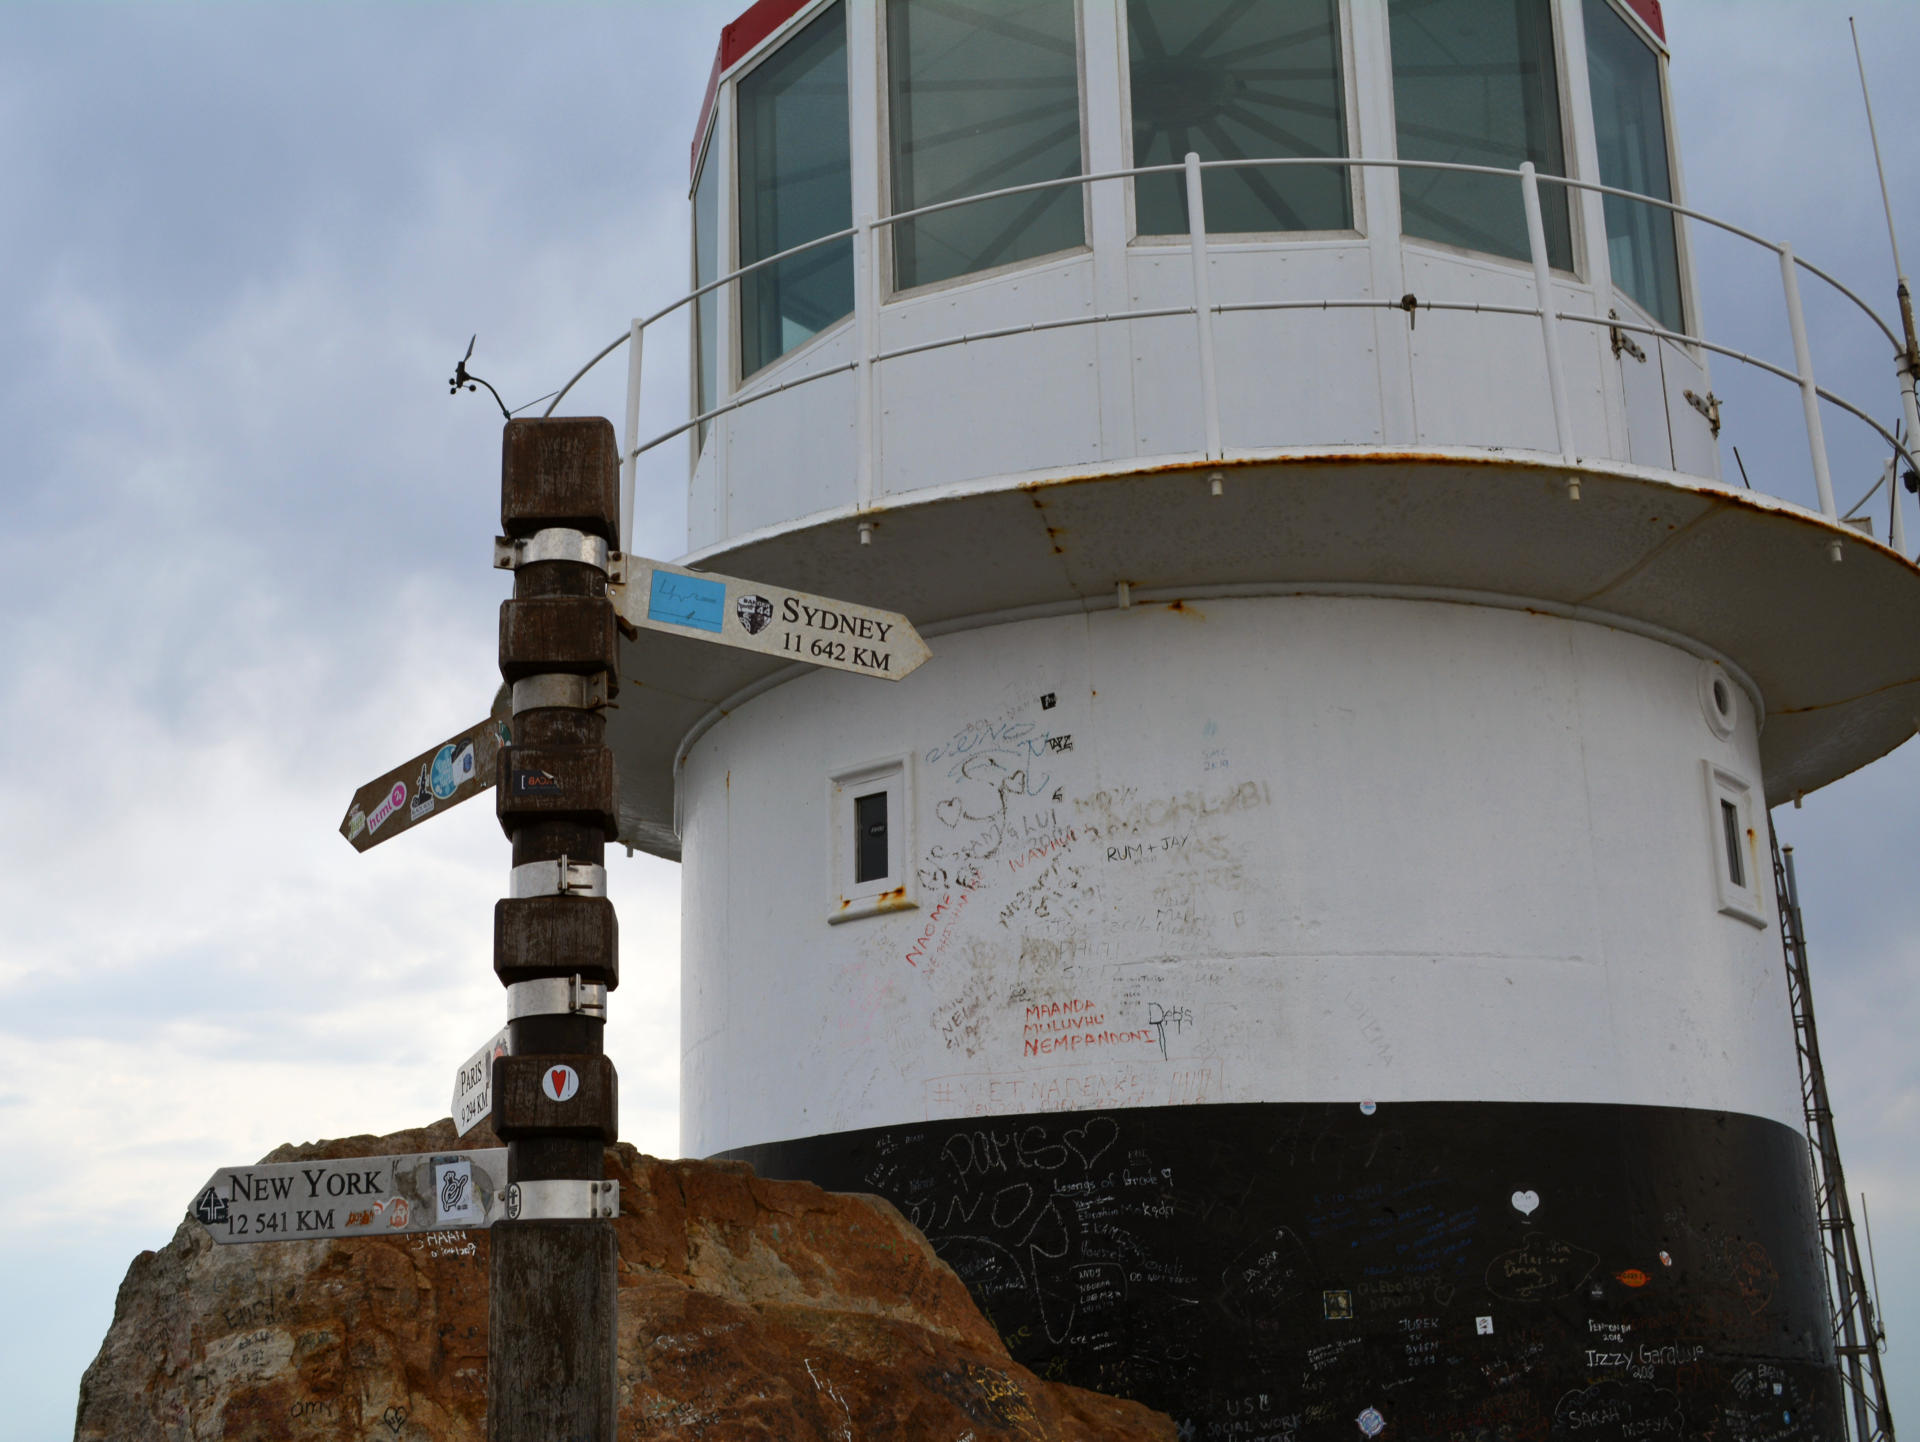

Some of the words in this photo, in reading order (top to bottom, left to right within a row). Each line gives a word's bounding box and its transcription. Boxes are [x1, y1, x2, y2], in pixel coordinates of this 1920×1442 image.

[782, 597, 893, 642] SYDNEY
[783, 632, 802, 653] 11
[810, 638, 846, 662] 642
[852, 647, 891, 671] KM
[1106, 844, 1143, 862] RUM
[1160, 833, 1191, 852] JAY
[460, 1061, 483, 1096] PARIS
[461, 1108, 466, 1127] 9
[466, 1102, 477, 1123] 294
[477, 1087, 489, 1113] KM
[229, 1173, 294, 1202] NEW
[302, 1170, 384, 1199] YORK
[228, 1213, 248, 1235] 12
[255, 1210, 288, 1232] 541
[296, 1208, 335, 1231] KM
